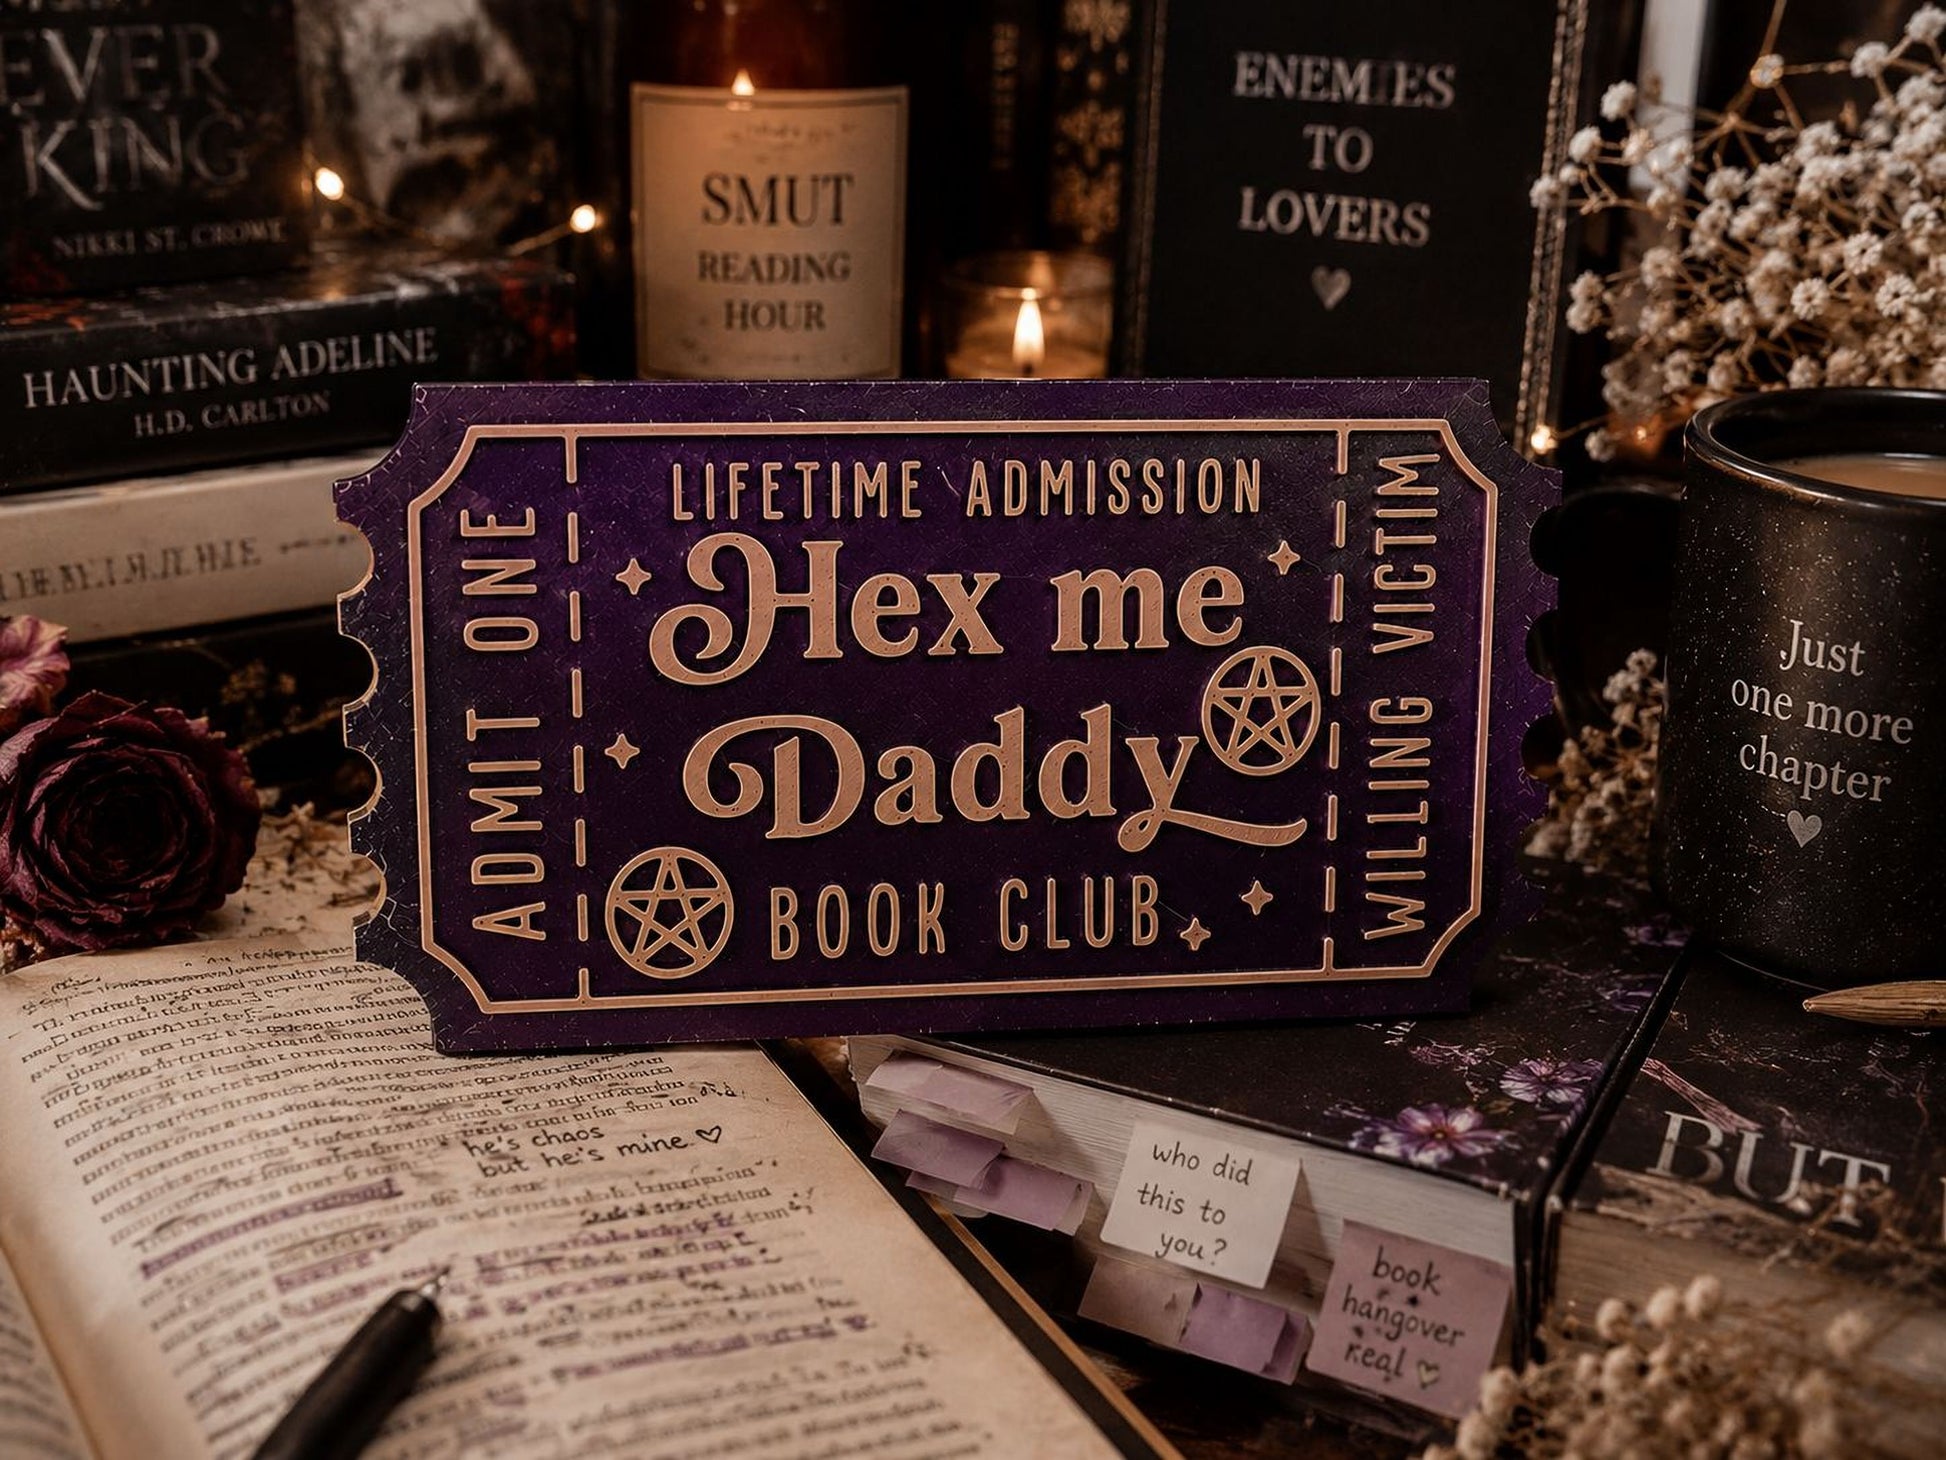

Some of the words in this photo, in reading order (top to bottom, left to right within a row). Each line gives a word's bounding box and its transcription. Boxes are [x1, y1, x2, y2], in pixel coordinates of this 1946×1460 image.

[0, 23, 231, 106] EVER
[1233, 50, 1457, 109] ENEMIES
[20, 112, 250, 210] KING
[1303, 123, 1374, 174] TO
[702, 170, 855, 228] SMUT
[1238, 186, 1432, 248] LOVERS
[51, 230, 136, 259] NIKKI
[698, 251, 851, 285] READING
[724, 299, 826, 333] HOUR
[23, 347, 258, 409] HAUNTING
[270, 326, 439, 381] ADELINE
[134, 408, 194, 439] H.D.
[202, 388, 333, 429] CARLTON
[673, 461, 922, 521] LIFETIME
[965, 457, 1261, 518] ADMISSION
[460, 506, 540, 652] ONE
[1372, 454, 1441, 655] VICTIM
[649, 531, 1004, 686] Hex
[1049, 565, 1245, 652] me
[1779, 619, 1866, 677] Just
[1731, 679, 1793, 721] one
[1803, 699, 1914, 745] more
[682, 703, 1307, 852] Daddy
[1739, 734, 1892, 802] chapter
[466, 708, 547, 941] ADMIT
[1364, 697, 1434, 940] WILLING
[770, 881, 946, 961] BOOK
[999, 875, 1159, 952] CLUB
[462, 1135, 521, 1158] he's
[531, 1124, 606, 1148] chaos
[477, 1155, 530, 1178] but
[618, 1131, 689, 1158] mine
[1153, 1140, 1200, 1170] who
[1212, 1152, 1253, 1186] did
[1646, 1110, 1891, 1228] BUT
[1137, 1182, 1186, 1215] this
[1200, 1199, 1227, 1226] to
[1372, 1244, 1442, 1297] book
[1342, 1283, 1466, 1348] hangover
